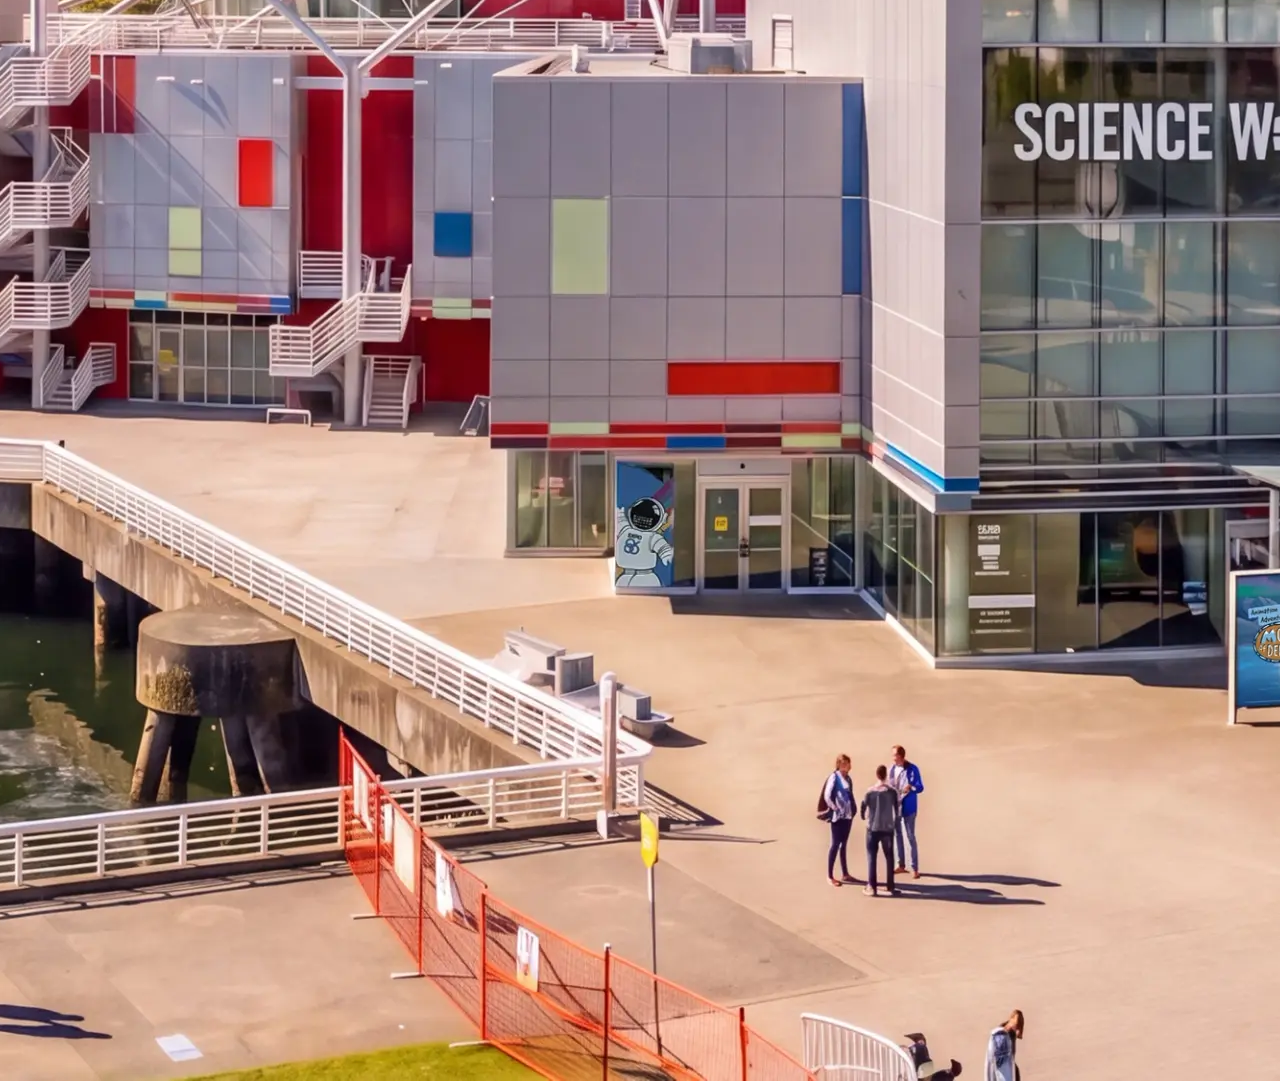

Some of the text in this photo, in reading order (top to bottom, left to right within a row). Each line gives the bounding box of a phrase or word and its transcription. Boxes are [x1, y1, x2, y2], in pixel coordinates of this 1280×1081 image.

[1013, 102, 1213, 161] SCIENCE
[624, 539, 640, 555] 86
[1251, 607, 1278, 615] Animation
